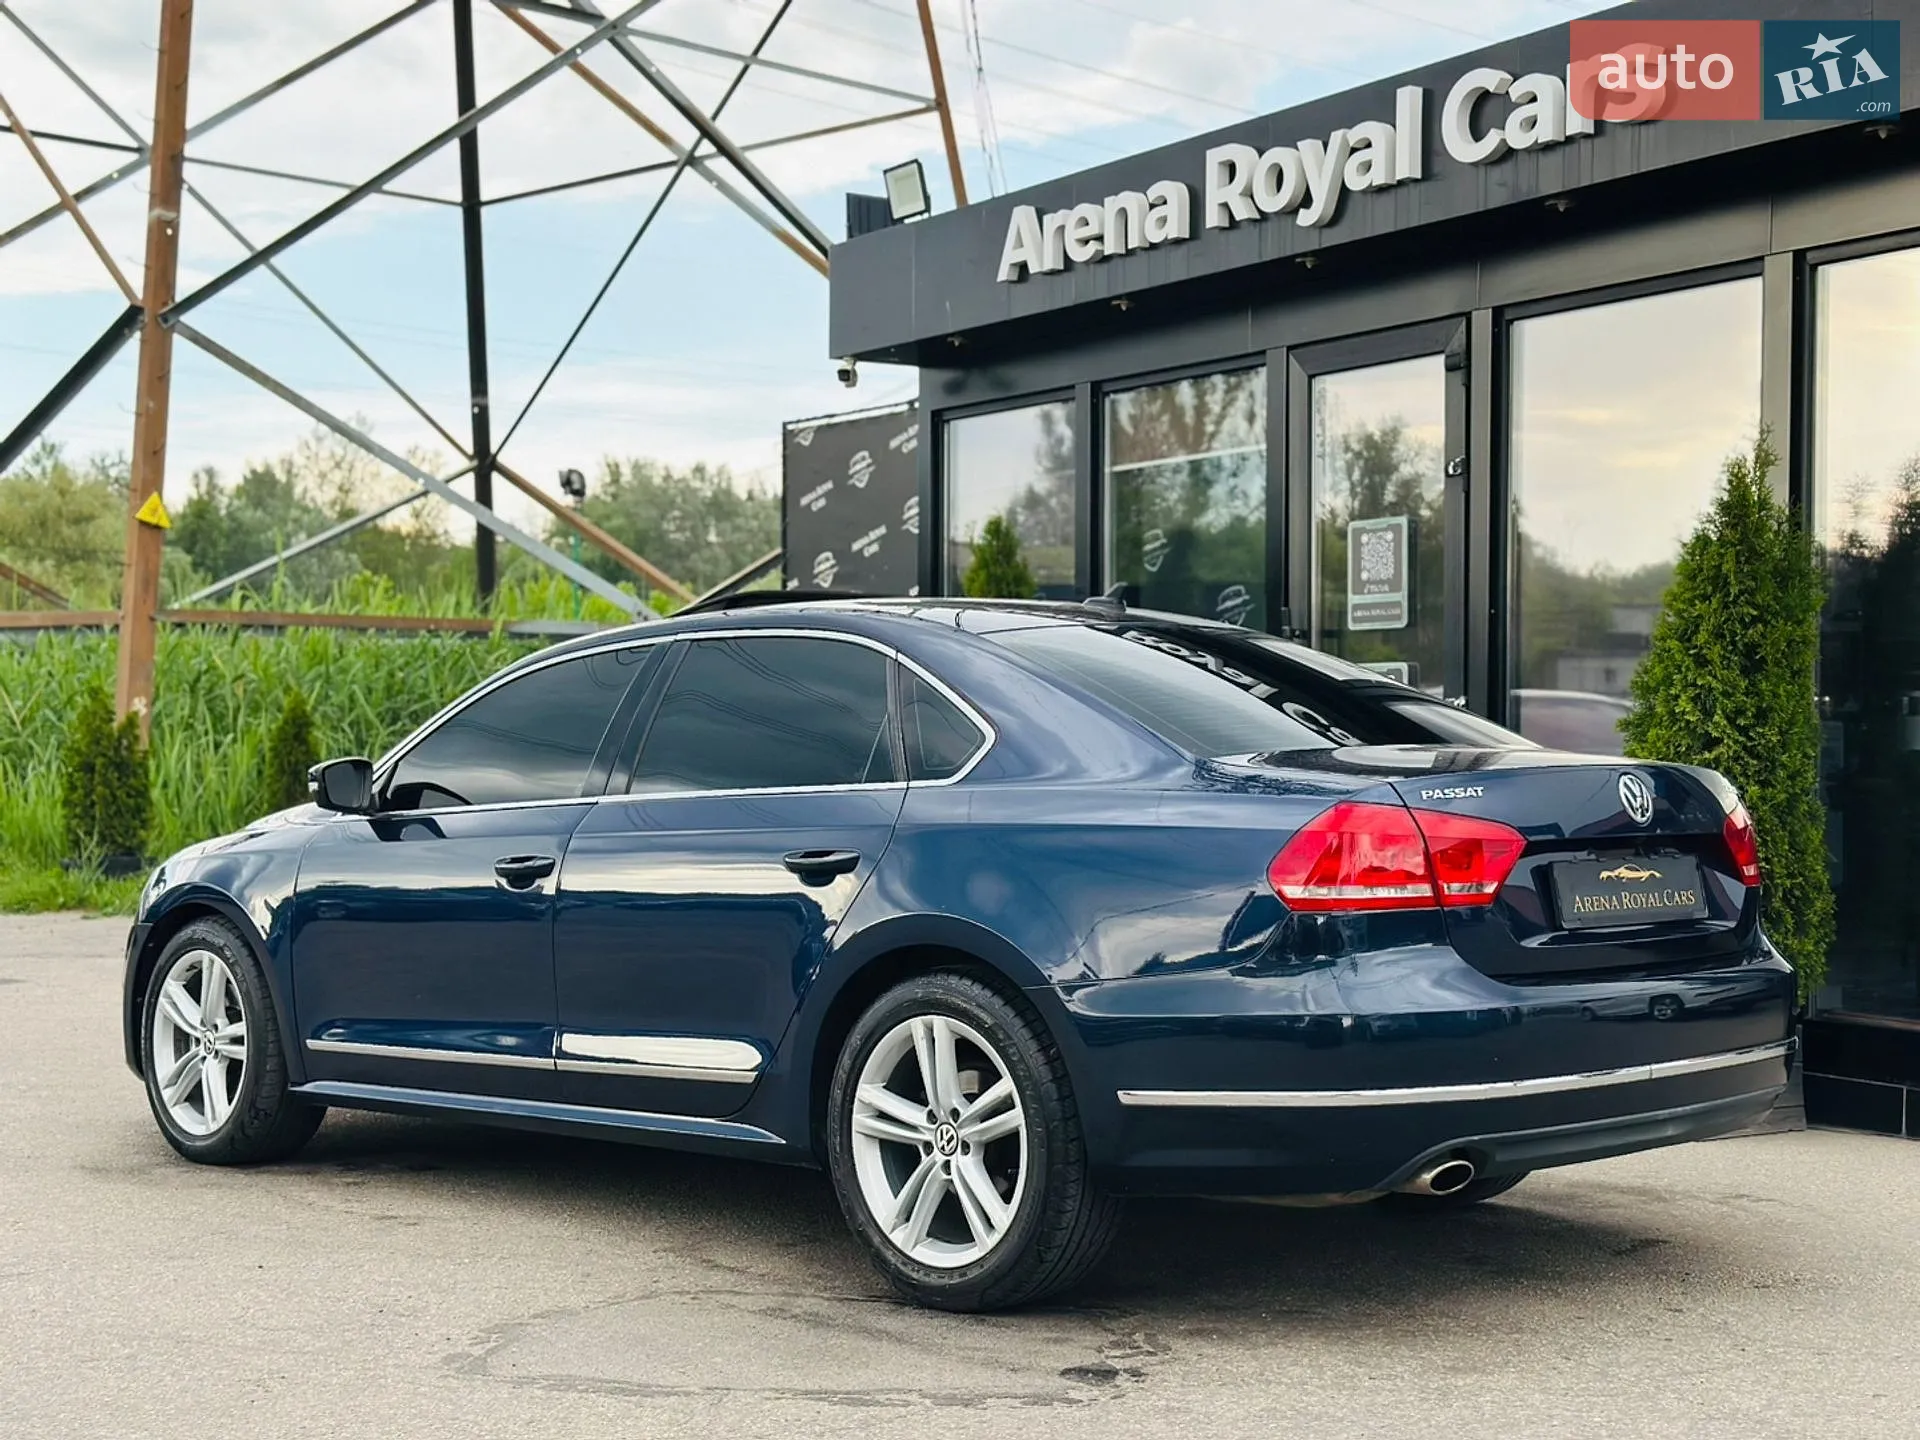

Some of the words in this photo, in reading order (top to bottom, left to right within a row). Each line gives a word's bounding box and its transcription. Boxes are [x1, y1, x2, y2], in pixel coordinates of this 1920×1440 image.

[997, 180, 1191, 282] Arena
[1206, 85, 1423, 228] Royal
[1421, 786, 1484, 800] PASSAT
